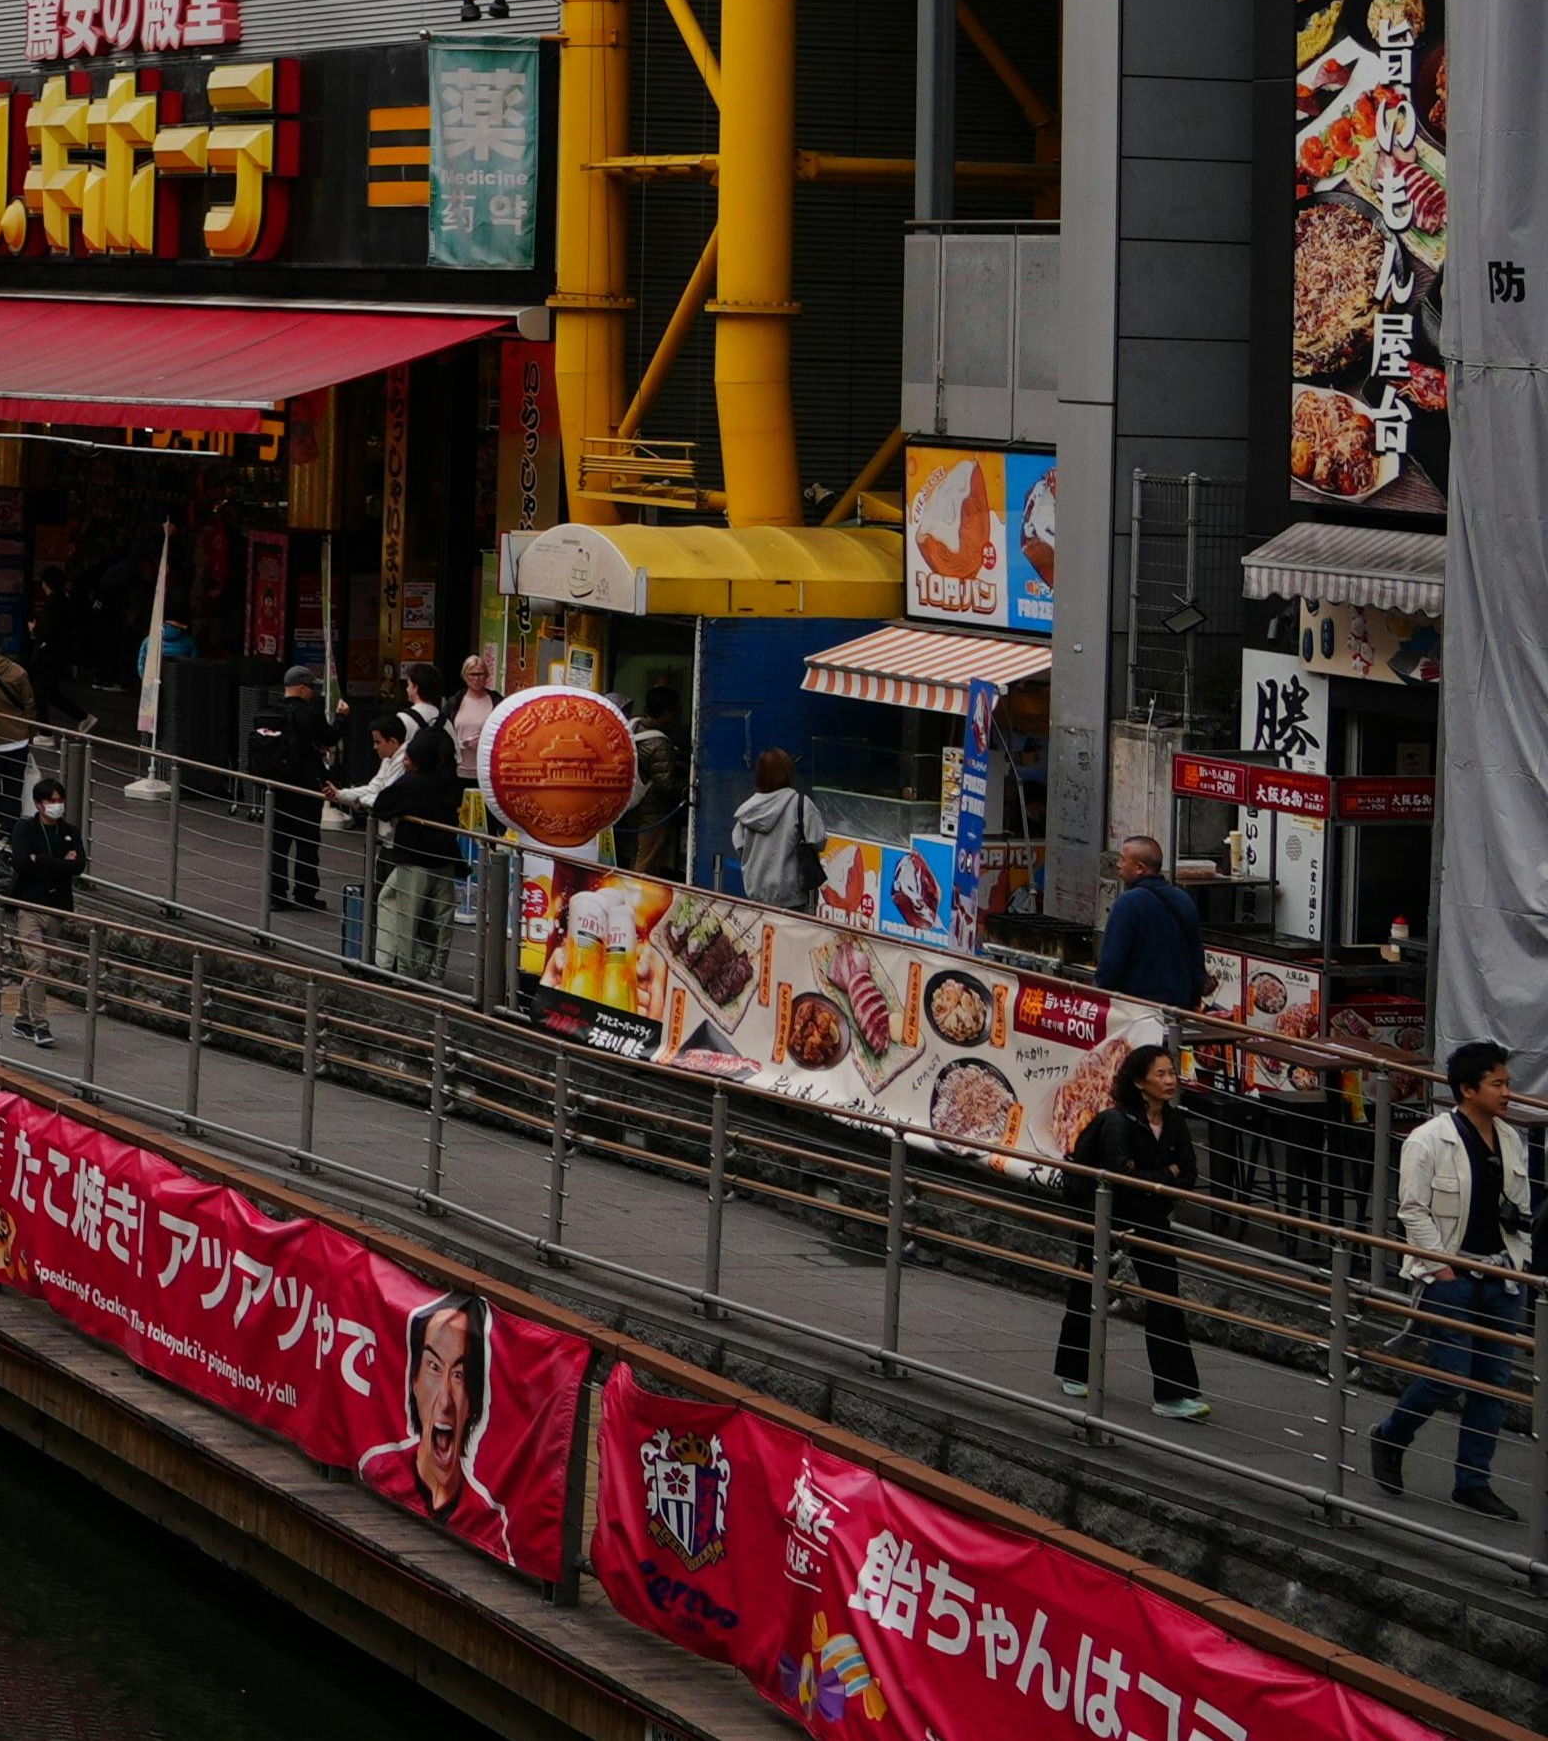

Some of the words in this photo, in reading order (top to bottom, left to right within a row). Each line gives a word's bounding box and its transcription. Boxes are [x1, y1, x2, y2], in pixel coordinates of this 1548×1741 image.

[440, 68, 526, 162] 薬
[440, 169, 528, 186] Medicine
[1370, 18, 1416, 456] 旨いもん屋台
[1488, 262, 1525, 304] 防
[915, 571, 997, 614] 10円パン
[1217, 781, 1236, 795] PON
[1255, 783, 1303, 808] 大阪名物
[1044, 991, 1099, 1022] 旨いもん屋台
[1067, 1019, 1096, 1042] PON
[9, 1131, 147, 1278] たこ焼き!
[157, 1212, 377, 1398] アツアツやで
[33, 1259, 83, 1298] Speaking
[131, 1308, 146, 1335] The
[147, 1316, 207, 1368] takoyaki's
[207, 1351, 238, 1388] piping
[267, 1375, 298, 1408] y'all!
